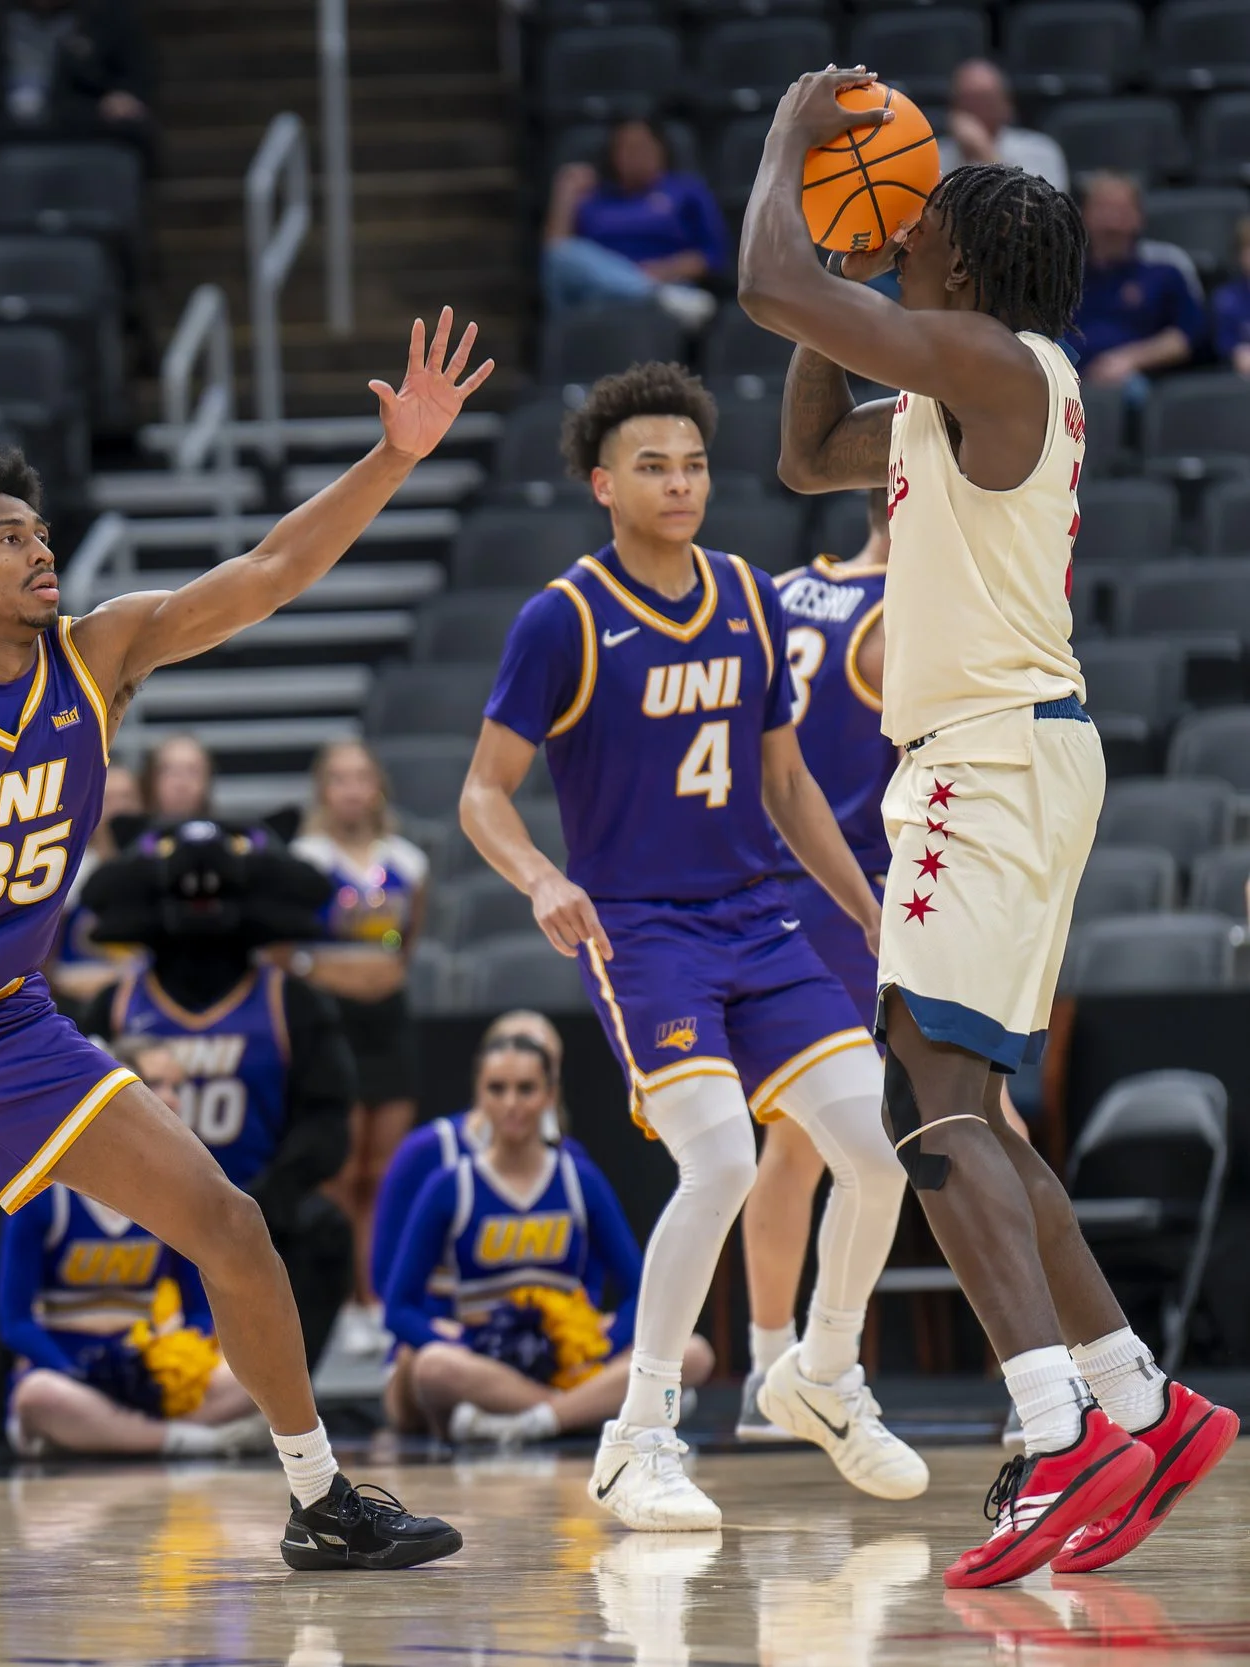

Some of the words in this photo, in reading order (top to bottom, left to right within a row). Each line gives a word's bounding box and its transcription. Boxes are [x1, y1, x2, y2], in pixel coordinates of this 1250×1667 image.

[641, 656, 742, 719] UNI
[51, 706, 80, 729] VALLEY
[676, 720, 732, 808] 4
[60, 1238, 161, 1285] UNI
[473, 1211, 571, 1267] UNI
